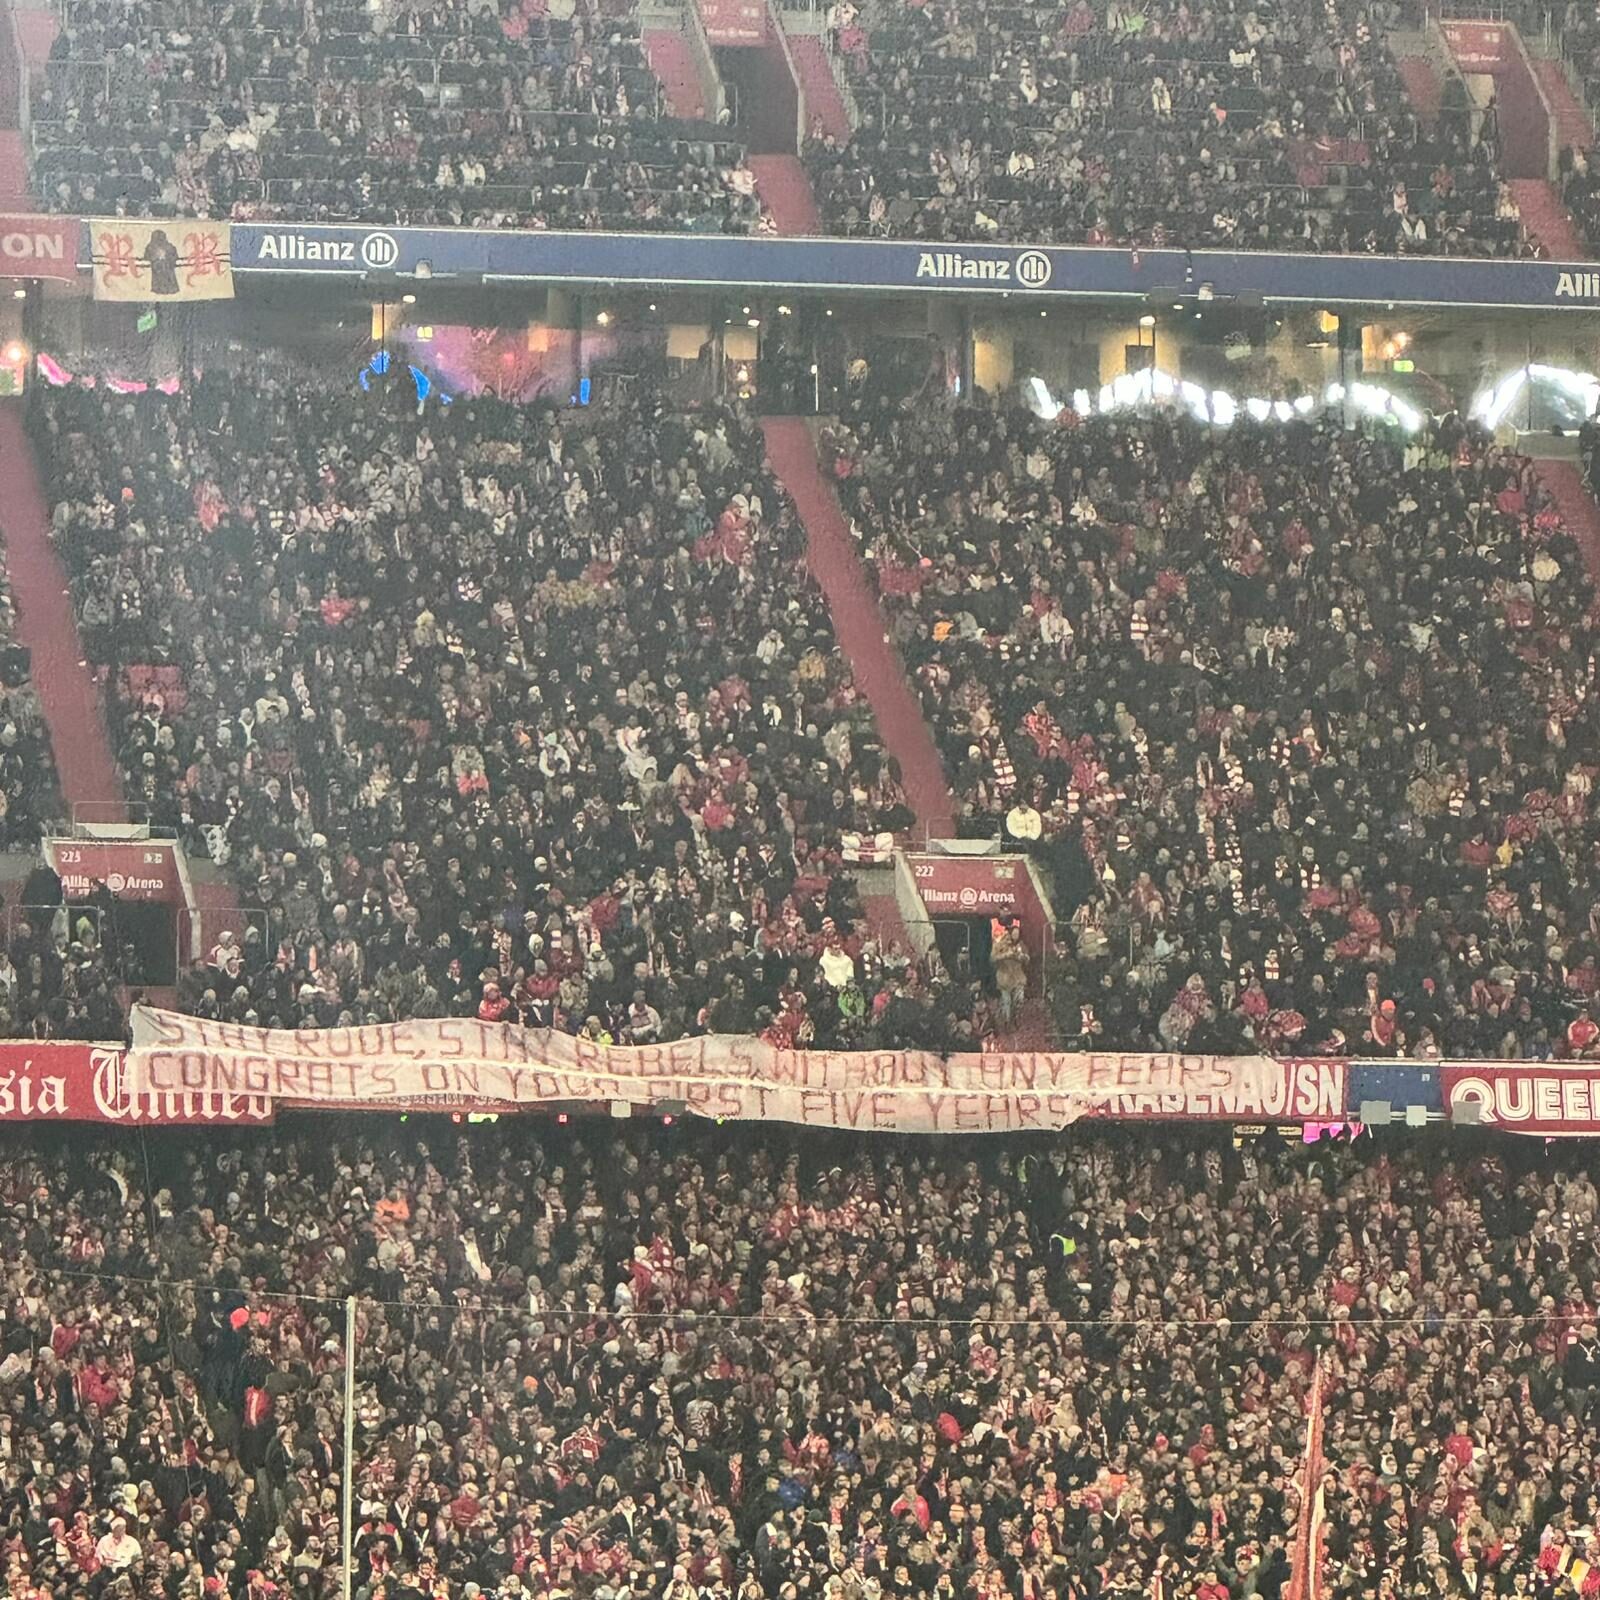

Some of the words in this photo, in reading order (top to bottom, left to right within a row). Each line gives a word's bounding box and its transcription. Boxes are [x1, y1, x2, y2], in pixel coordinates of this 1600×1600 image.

[2, 233, 63, 259] ON
[258, 235, 355, 262] Allianz
[916, 253, 1011, 280] Allianz
[1555, 272, 1600, 297] Alli
[61, 875, 105, 889] Allia
[127, 876, 164, 889] Arena
[915, 865, 934, 877] 222
[921, 890, 958, 903] llianz
[979, 890, 1015, 903] Arena
[156, 1013, 273, 1054] STAY
[981, 1053, 1064, 1089] ANY
[1088, 1054, 1232, 1086] FEARS
[150, 1051, 397, 1097] CONGRATS
[421, 1063, 480, 1091] ON
[504, 1066, 620, 1099] YOUR
[801, 1090, 897, 1128] FIVE
[926, 1093, 1070, 1129] YEARS
[1451, 1076, 1600, 1122] QUEE
